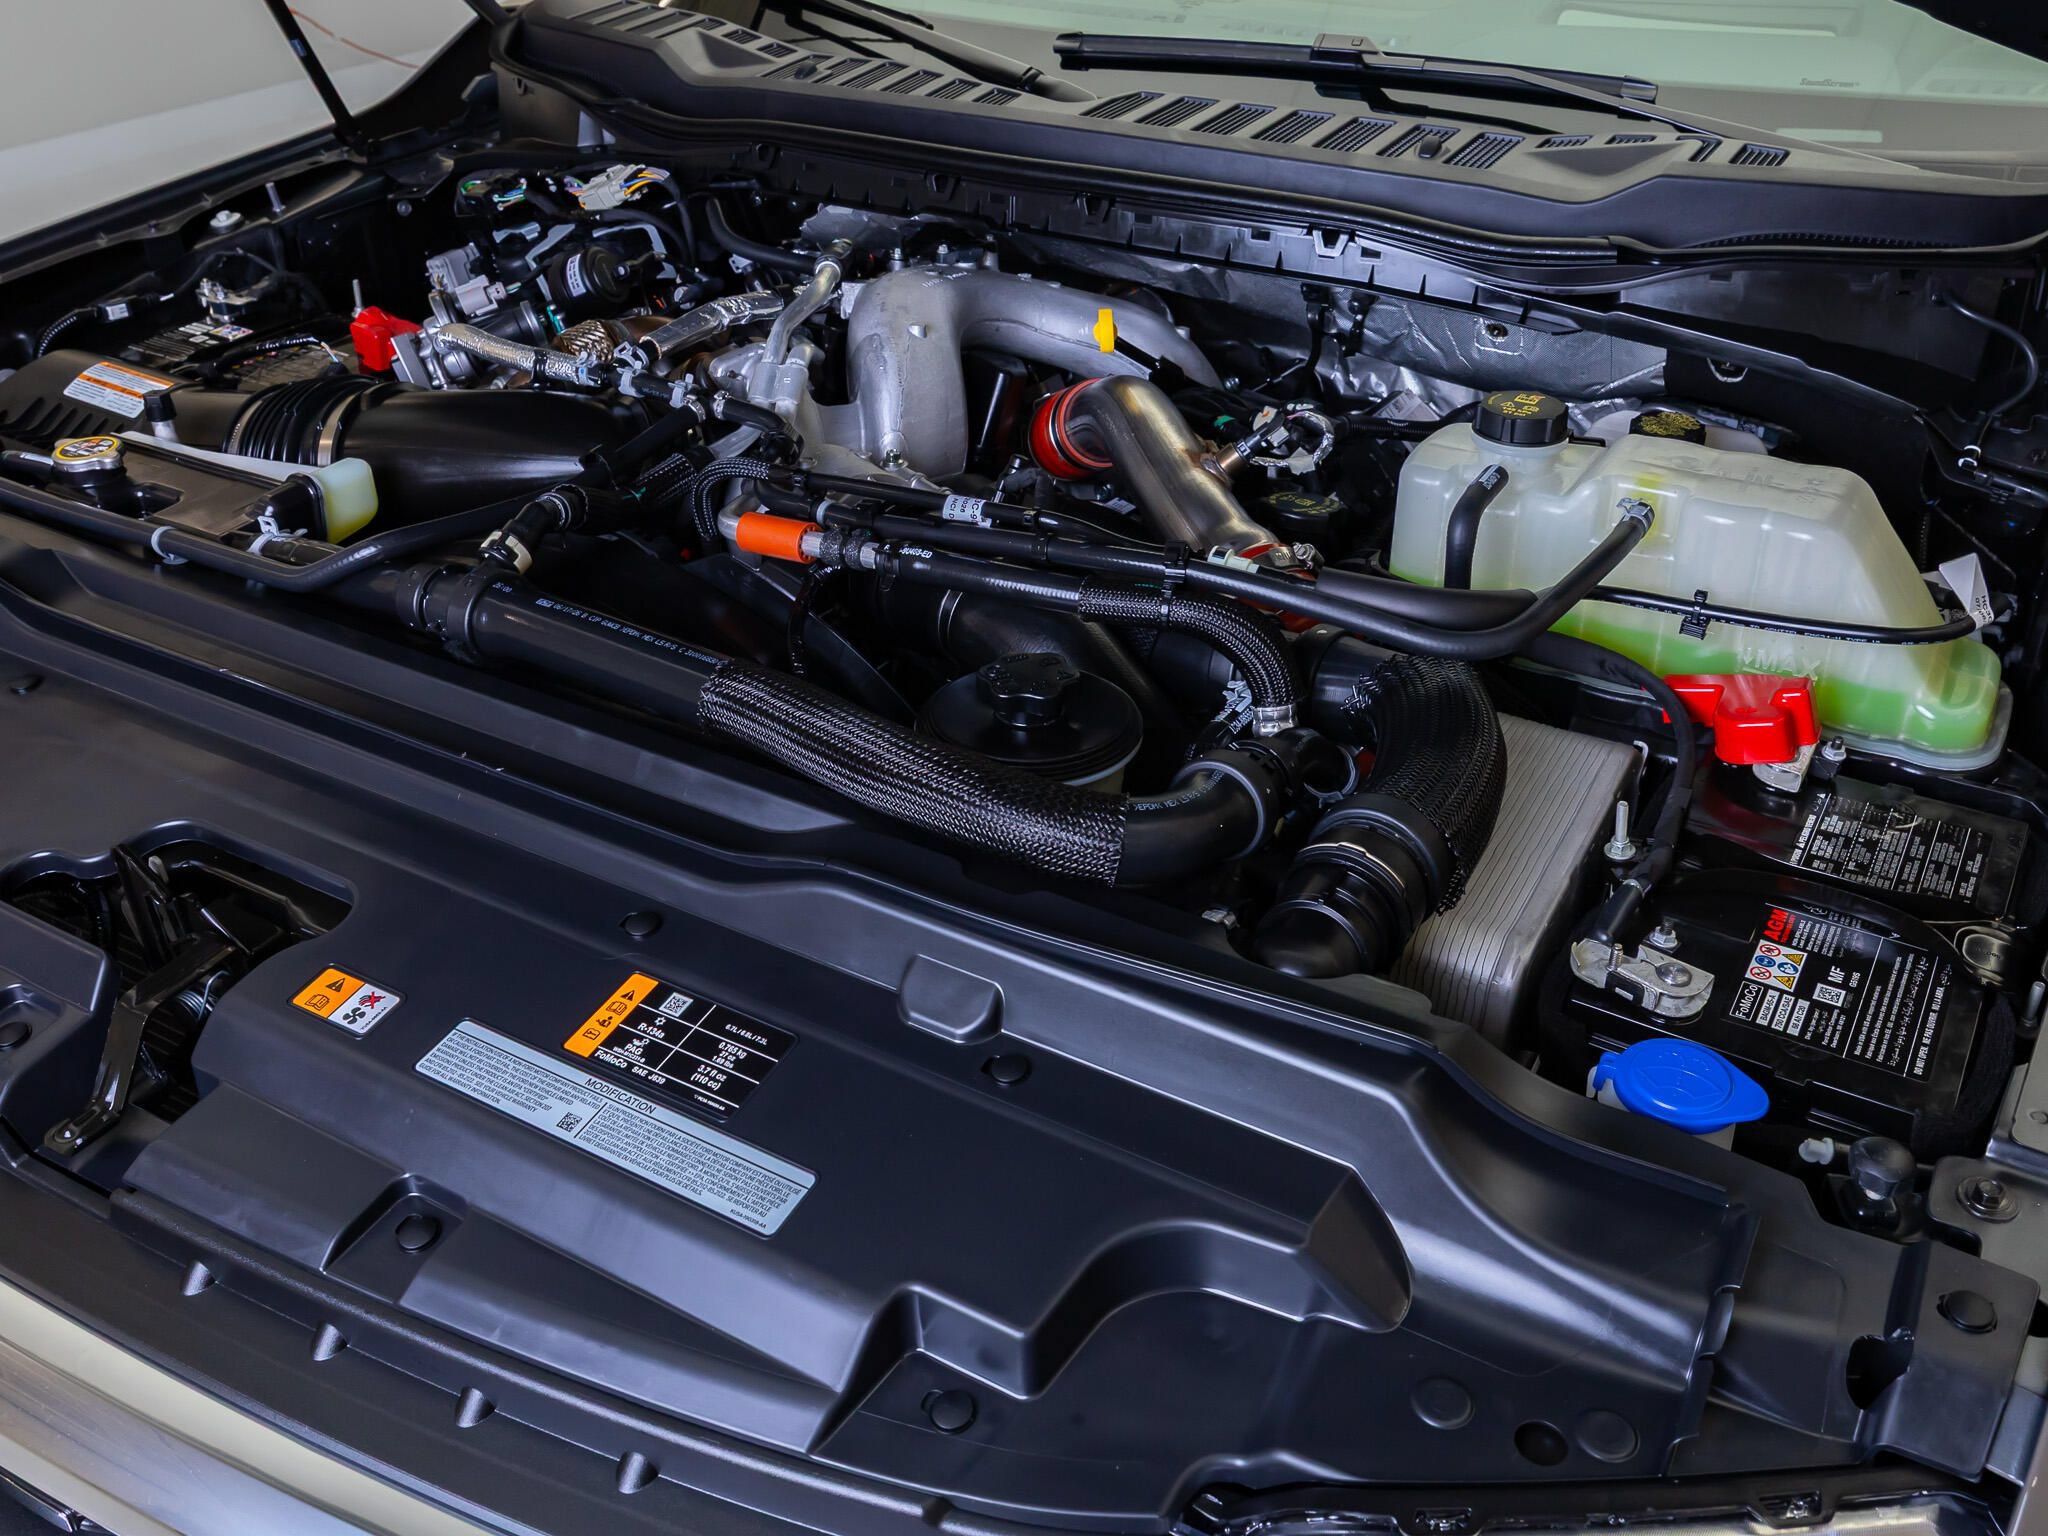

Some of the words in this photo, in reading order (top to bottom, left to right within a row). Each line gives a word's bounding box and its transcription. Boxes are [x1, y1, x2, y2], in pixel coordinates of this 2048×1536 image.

[1755, 649, 1820, 682] MAX
[1764, 909, 1787, 939] AGM
[1828, 966, 1844, 982] MF
[1735, 985, 1757, 1017] FoMoCo
[1778, 996, 1791, 1018] CCA/SAE
[1796, 1005, 1805, 1015] C20
[1774, 1018, 1783, 1028] 750
[1923, 1028, 1933, 1037] PAS
[624, 1043, 642, 1054] PAG
[718, 1042, 738, 1053] 0.765
[736, 1049, 746, 1058] kg
[1916, 1057, 1924, 1067] NOT
[1918, 1046, 1928, 1058] OPEN.
[418, 1062, 432, 1071] GUIDE
[448, 1076, 471, 1089] WARRANTY
[436, 1047, 459, 1060] WARRANTY
[458, 1057, 476, 1068] UNLESS
[482, 1068, 503, 1080] PRODUCT
[440, 1041, 459, 1052] DAMAGE
[482, 1061, 502, 1072] COVERED
[515, 1076, 529, 1084] FORD
[538, 1086, 556, 1097] VEHICLE
[554, 1094, 573, 1105] LIMITED
[452, 1039, 469, 1049] CAUSES
[545, 1081, 561, 1091] REPAIR
[579, 1097, 600, 1109] RELATED
[594, 1050, 626, 1067] FoMoCo
[631, 1066, 648, 1076] SAE
[648, 1074, 665, 1084] J639
[697, 1064, 711, 1073] 3.7
[430, 1052, 452, 1065] EMISSIONS
[451, 1062, 472, 1073] PRODUCT
[470, 1070, 486, 1080] UNDER
[493, 1081, 508, 1090] CLEAN
[524, 1095, 543, 1107] SECTION
[533, 1069, 549, 1078] MOTOR
[548, 1075, 570, 1087] COMPANY
[569, 1085, 590, 1096] PRODUCT
[589, 1094, 602, 1102] FAILS
[690, 1072, 708, 1083] (110
[707, 1080, 720, 1090] cc)
[482, 1084, 496, 1092] YOUR
[494, 1090, 512, 1101] VEHICLE
[511, 1098, 536, 1112] WARRANTY
[585, 1078, 655, 1113] MODIFICATION
[597, 1128, 624, 1143] DISPOSITIFS
[624, 1141, 659, 1159] ANTIPOLLUTION
[599, 1122, 621, 1134] GARANTIE
[666, 1152, 680, 1160] NEUF
[702, 1169, 718, 1179] MOINS
[604, 1139, 620, 1148] CLEAN
[688, 1148, 704, 1158] CAUSE
[664, 1144, 690, 1158] DOMMAGES
[690, 1156, 715, 1170] CONNEXES
[722, 1170, 741, 1182] SERONT
[750, 1184, 776, 1198] COUVERTS
[699, 1145, 713, 1154] FORD
[712, 1151, 730, 1162] MOTOR
[728, 1159, 752, 1172] COMPANY
